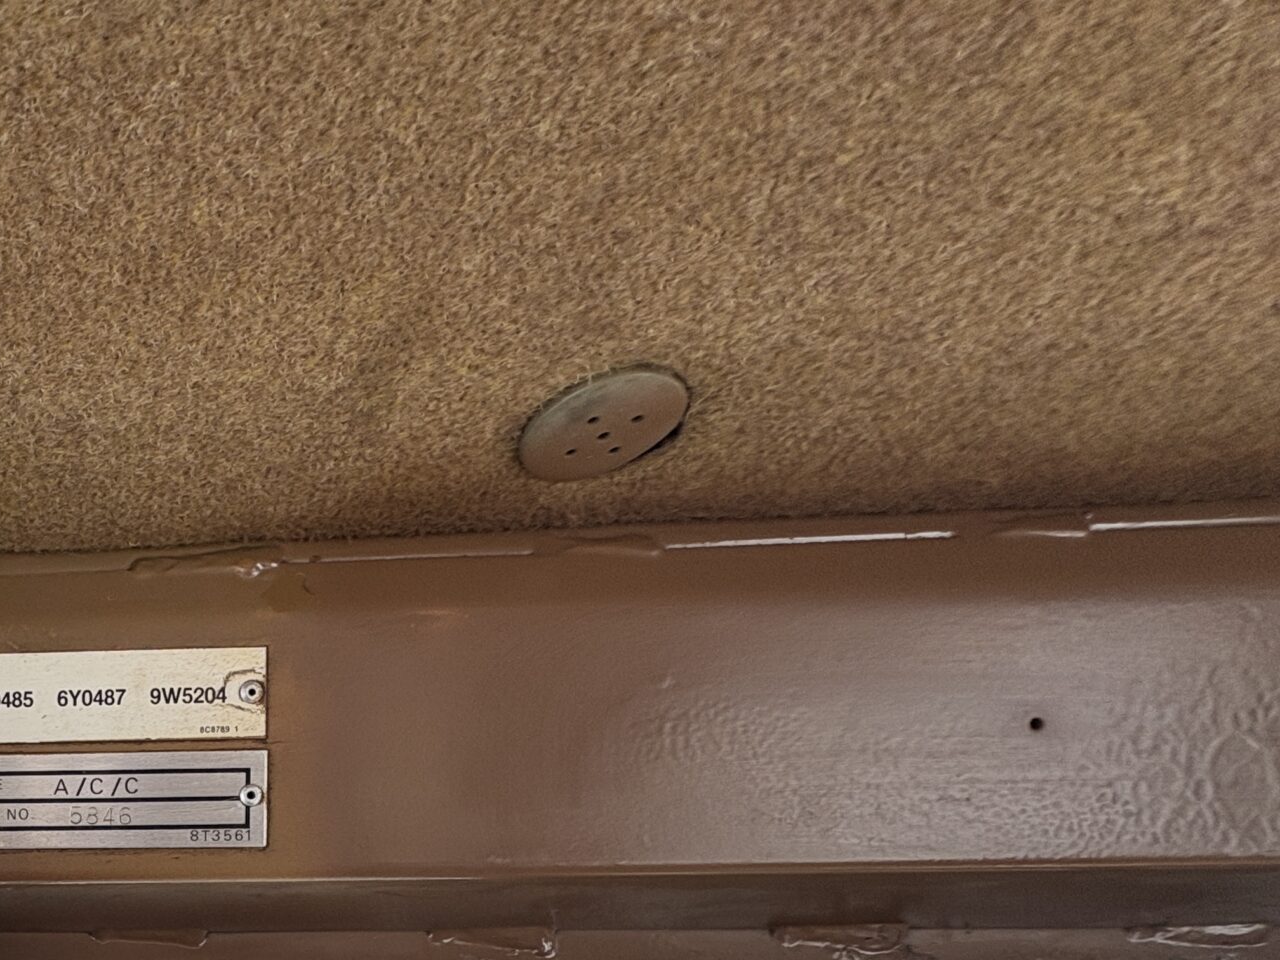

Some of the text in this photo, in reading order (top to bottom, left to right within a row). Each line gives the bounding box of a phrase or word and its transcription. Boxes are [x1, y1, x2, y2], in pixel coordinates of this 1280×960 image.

[57, 689, 127, 707] 6Y0487
[149, 687, 228, 705] 9W5204
[189, 829, 252, 842] 8T3561
